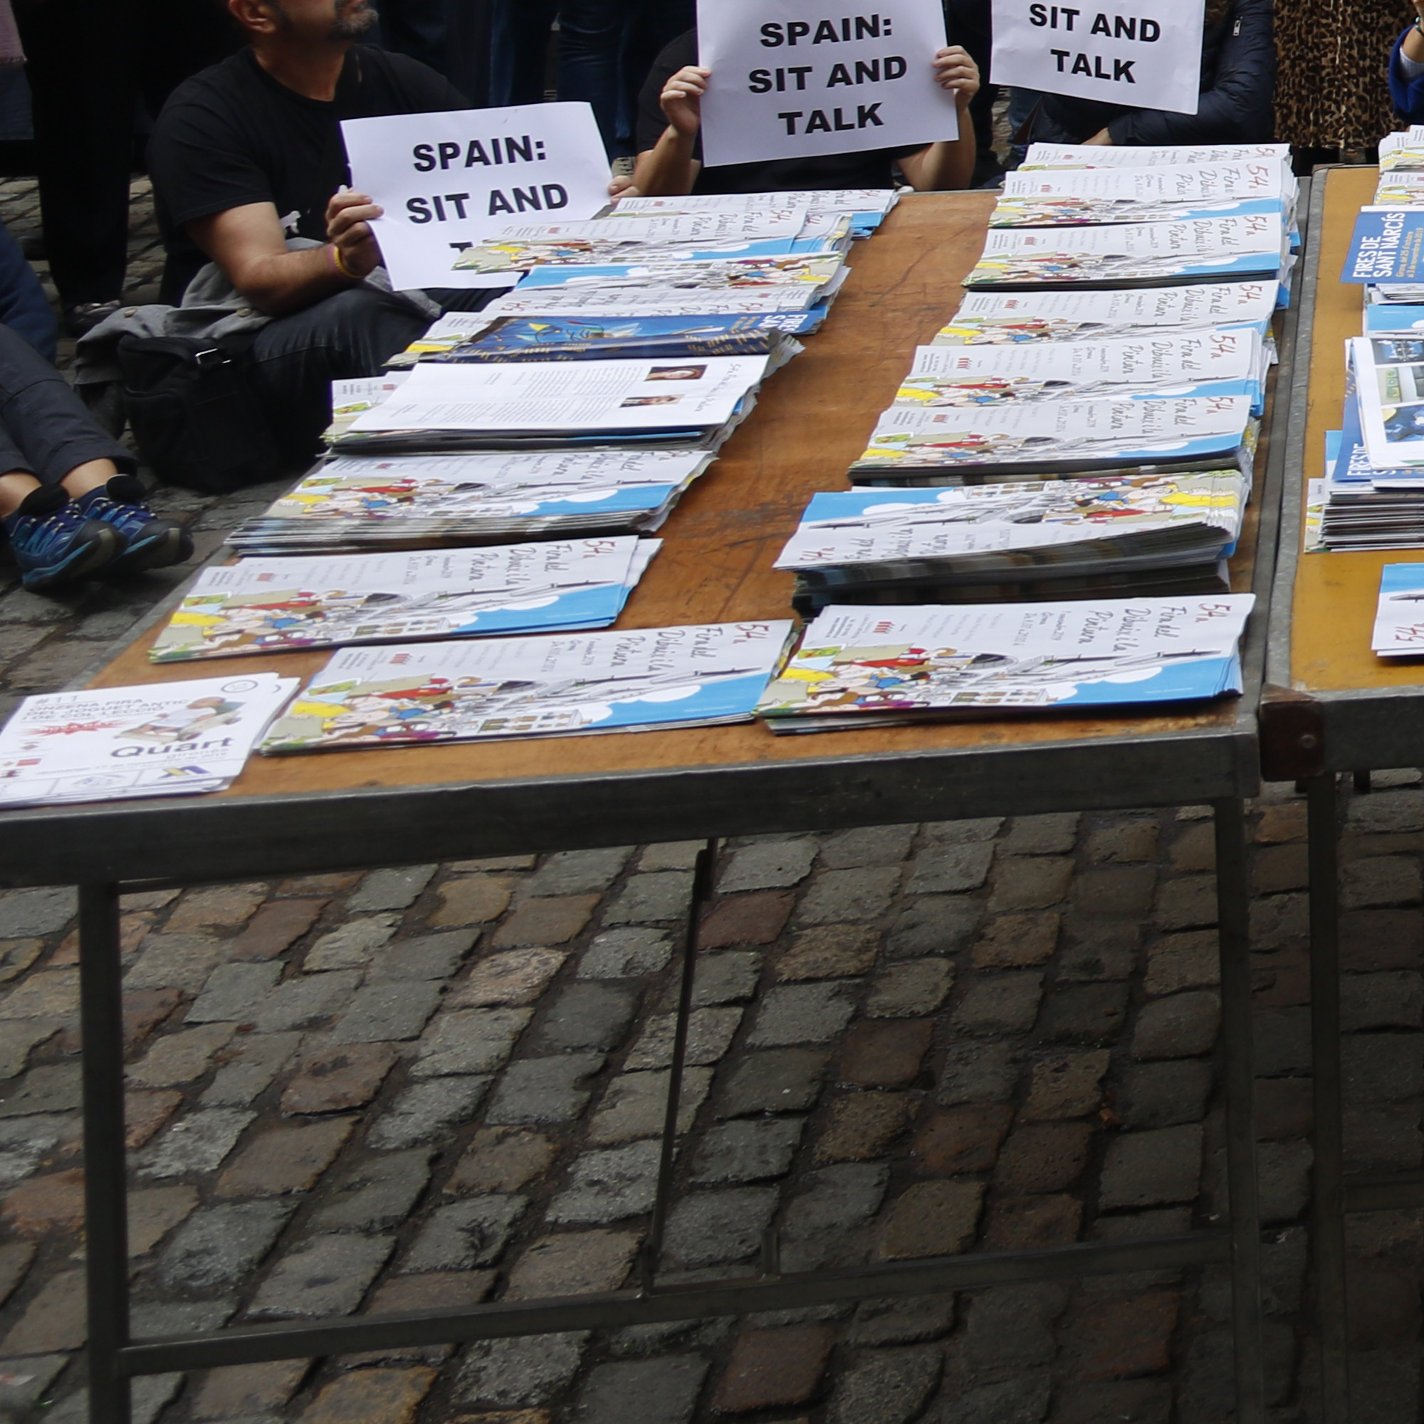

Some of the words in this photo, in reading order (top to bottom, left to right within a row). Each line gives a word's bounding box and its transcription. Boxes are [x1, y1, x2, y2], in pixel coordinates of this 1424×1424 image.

[760, 14, 891, 47] SPAIN:
[1029, 4, 1080, 31] SIT
[1090, 14, 1160, 42] AND
[749, 66, 812, 93] SIT
[826, 56, 906, 88] AND
[1050, 49, 1135, 83] TALK
[778, 103, 883, 135] TALK
[413, 136, 545, 172] SPAIN:
[406, 193, 469, 223] SIT
[489, 184, 568, 216] AND
[1360, 236, 1381, 250] DE
[1380, 212, 1406, 249] NARCÍS
[1352, 250, 1377, 278] FIRES
[1372, 251, 1397, 278] SANT
[110, 736, 235, 758] Quart
